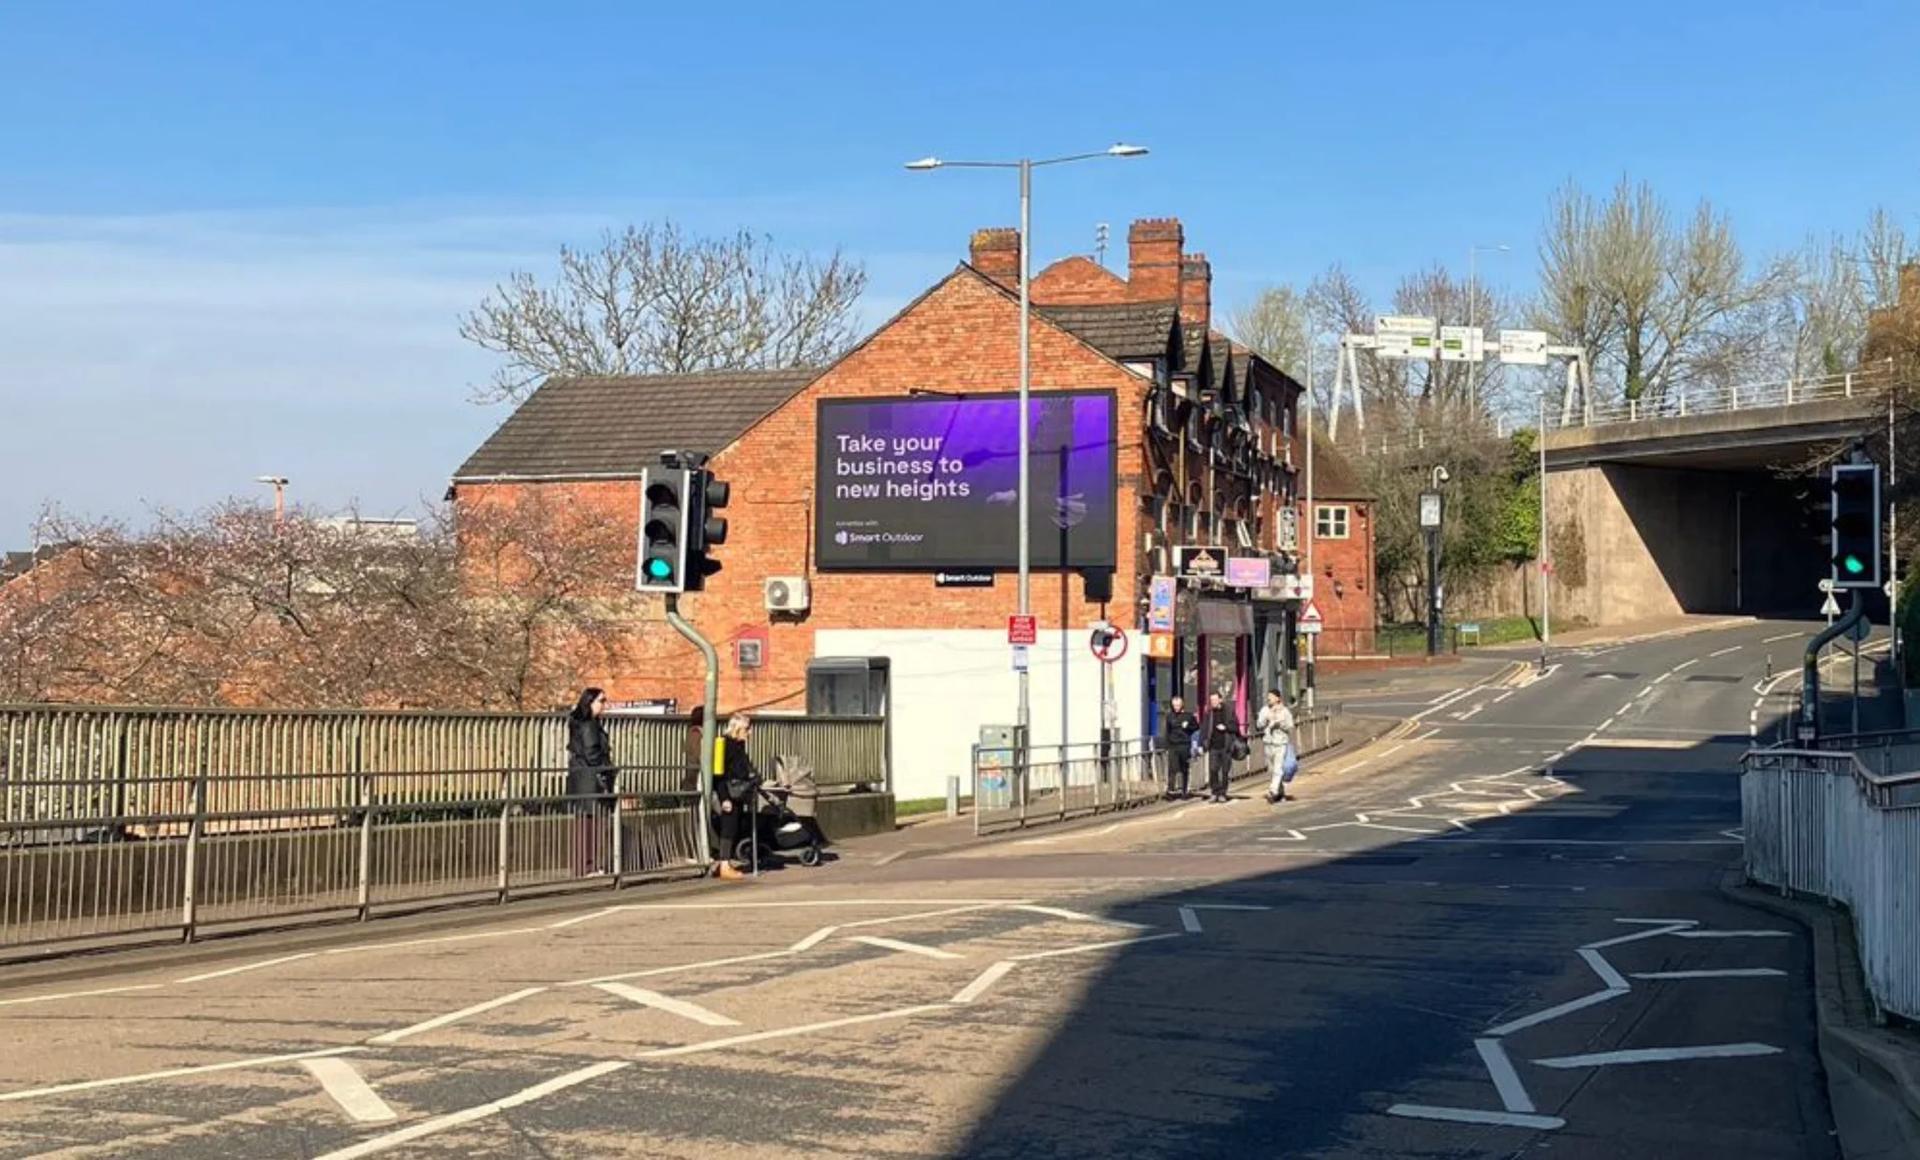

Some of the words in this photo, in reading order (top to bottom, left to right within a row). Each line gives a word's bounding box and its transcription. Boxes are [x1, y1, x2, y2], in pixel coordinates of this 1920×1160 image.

[836, 434, 886, 453] Take
[893, 436, 944, 456] your
[836, 457, 934, 476] business
[939, 457, 964, 474] to
[836, 482, 880, 499] new
[886, 479, 971, 501] heights
[849, 531, 881, 543] Smart
[882, 531, 925, 543] Outdoor
[945, 574, 965, 583] Smart
[965, 573, 992, 583] Outdoor
